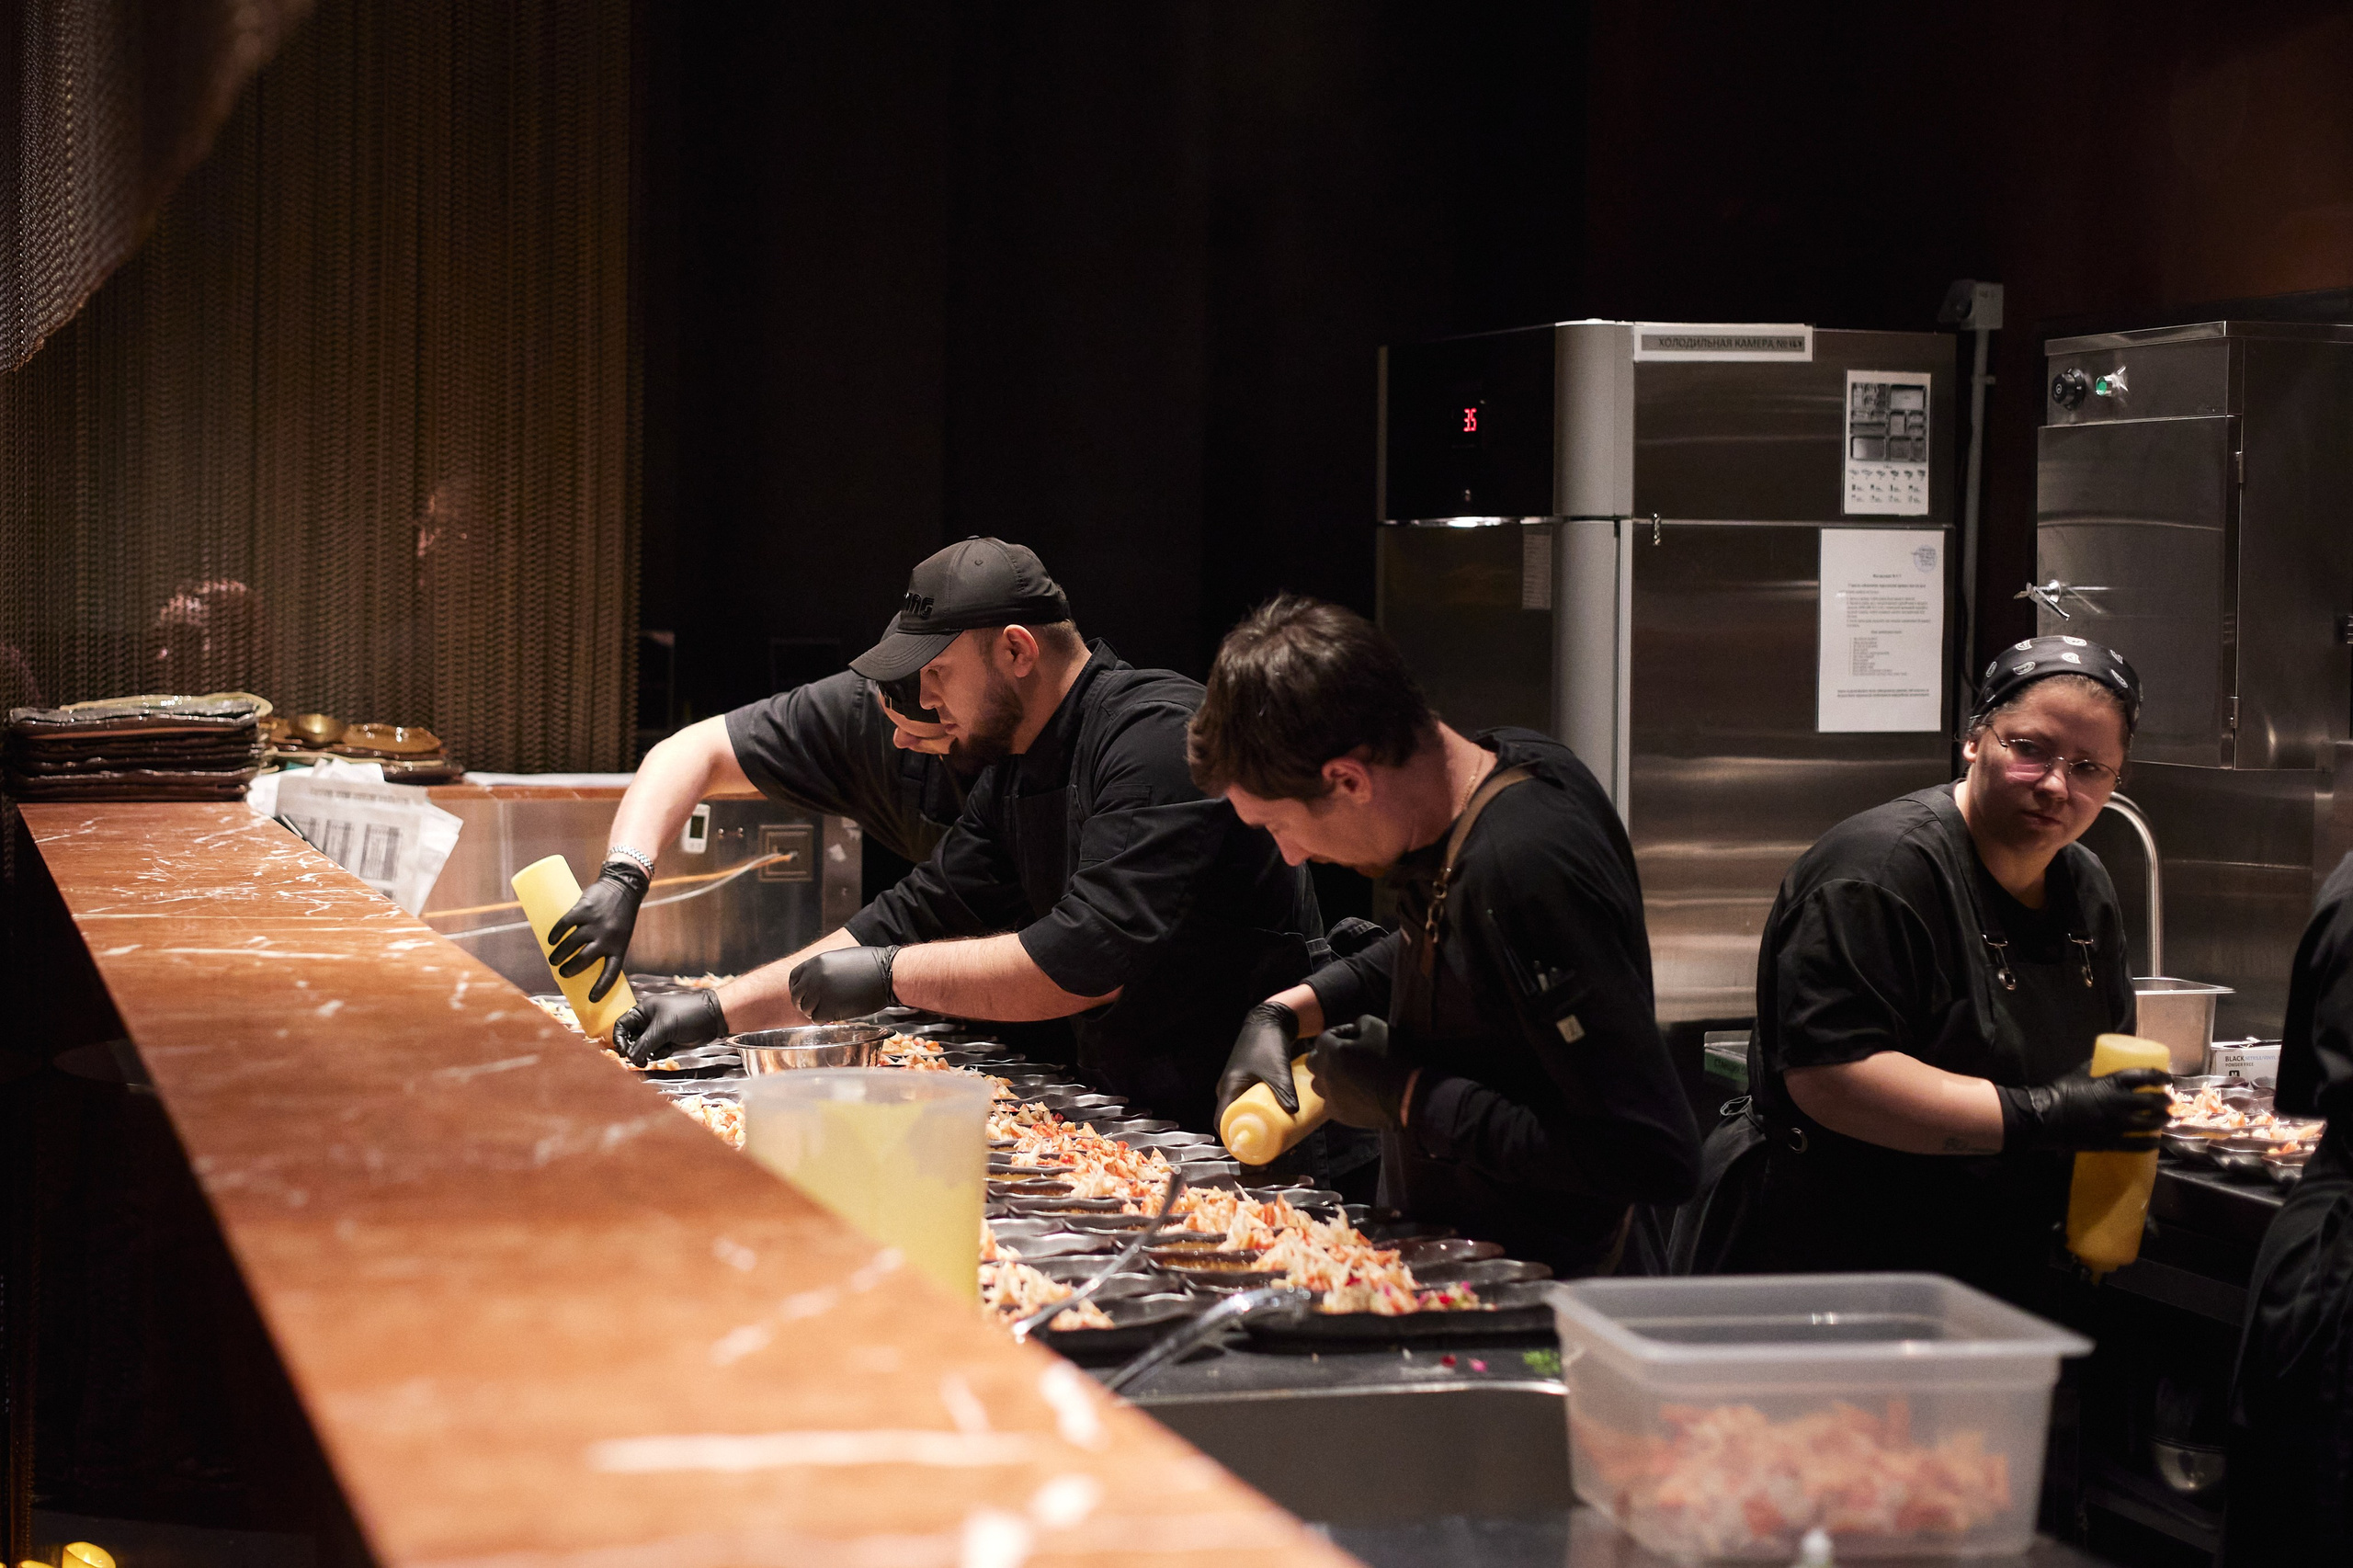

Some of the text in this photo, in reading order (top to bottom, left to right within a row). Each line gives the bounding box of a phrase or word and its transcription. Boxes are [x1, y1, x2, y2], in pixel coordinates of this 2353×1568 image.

[1659, 337, 1732, 349] ХОЛОДИЛЬНАЯ
[1734, 338, 1774, 350] КАМЕРА
[1463, 407, 1477, 432] 35
